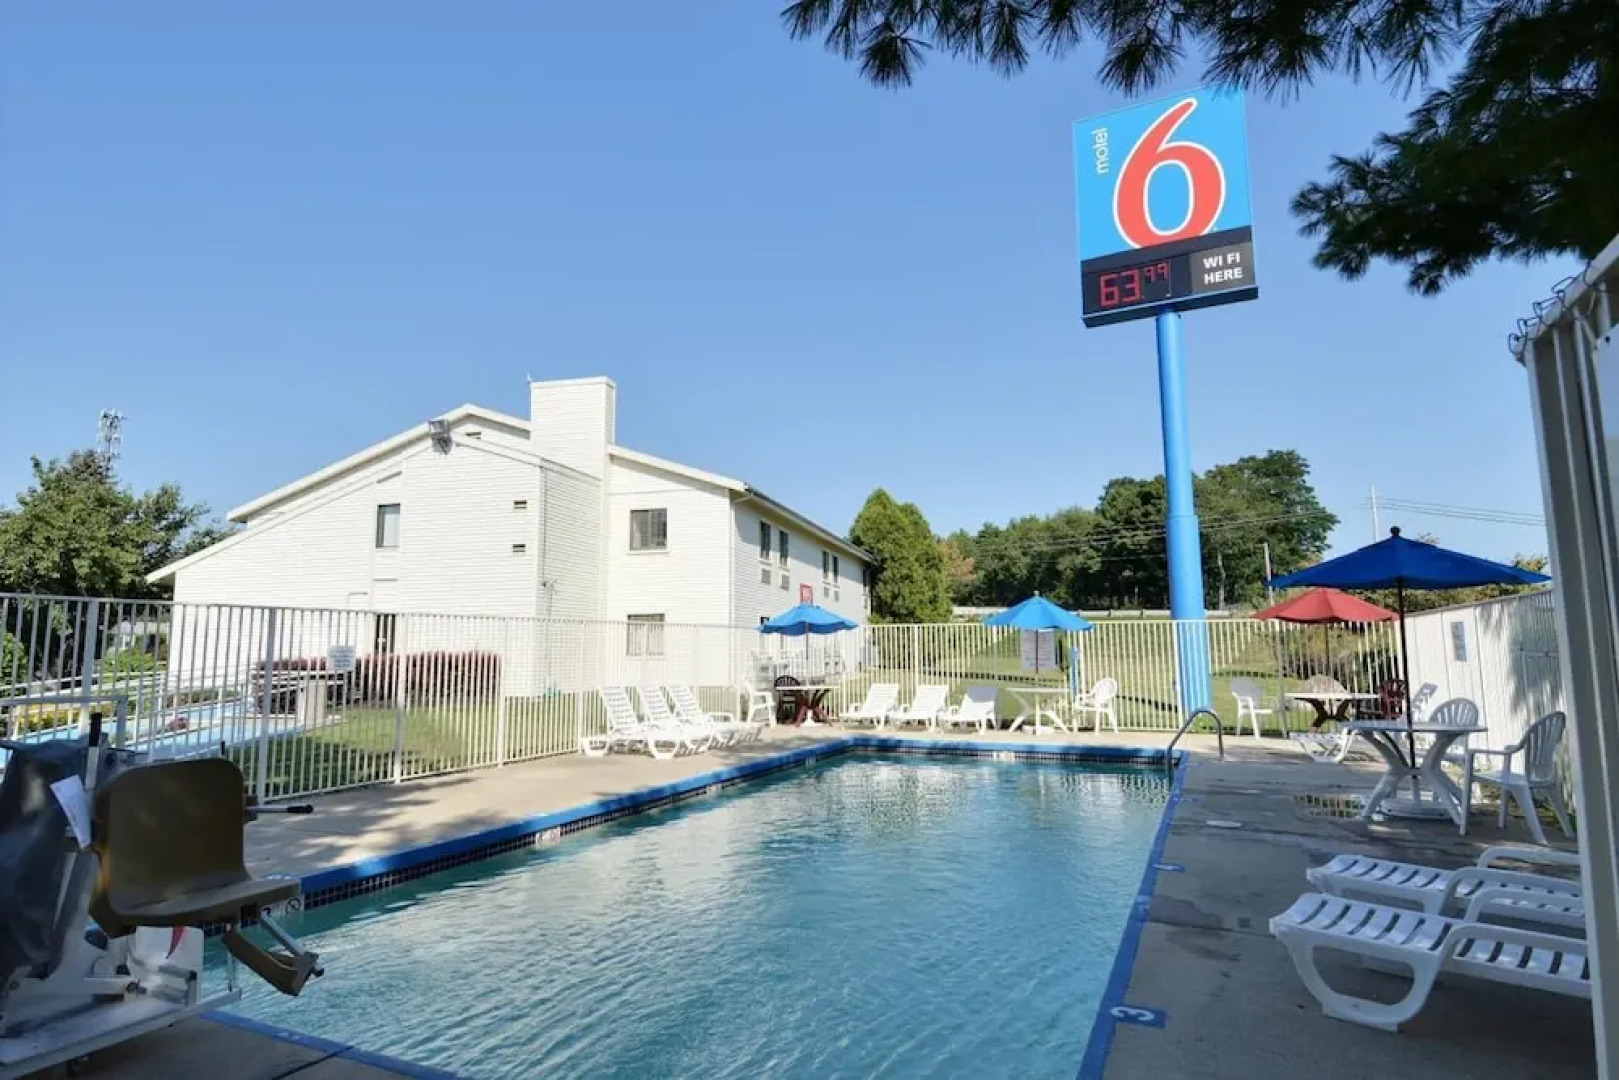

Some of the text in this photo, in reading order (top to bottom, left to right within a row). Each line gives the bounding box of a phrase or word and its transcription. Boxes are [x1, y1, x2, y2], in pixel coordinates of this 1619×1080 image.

[1092, 128, 1109, 174] motel
[1113, 98, 1226, 249] 6
[1204, 267, 1243, 284] HERE
